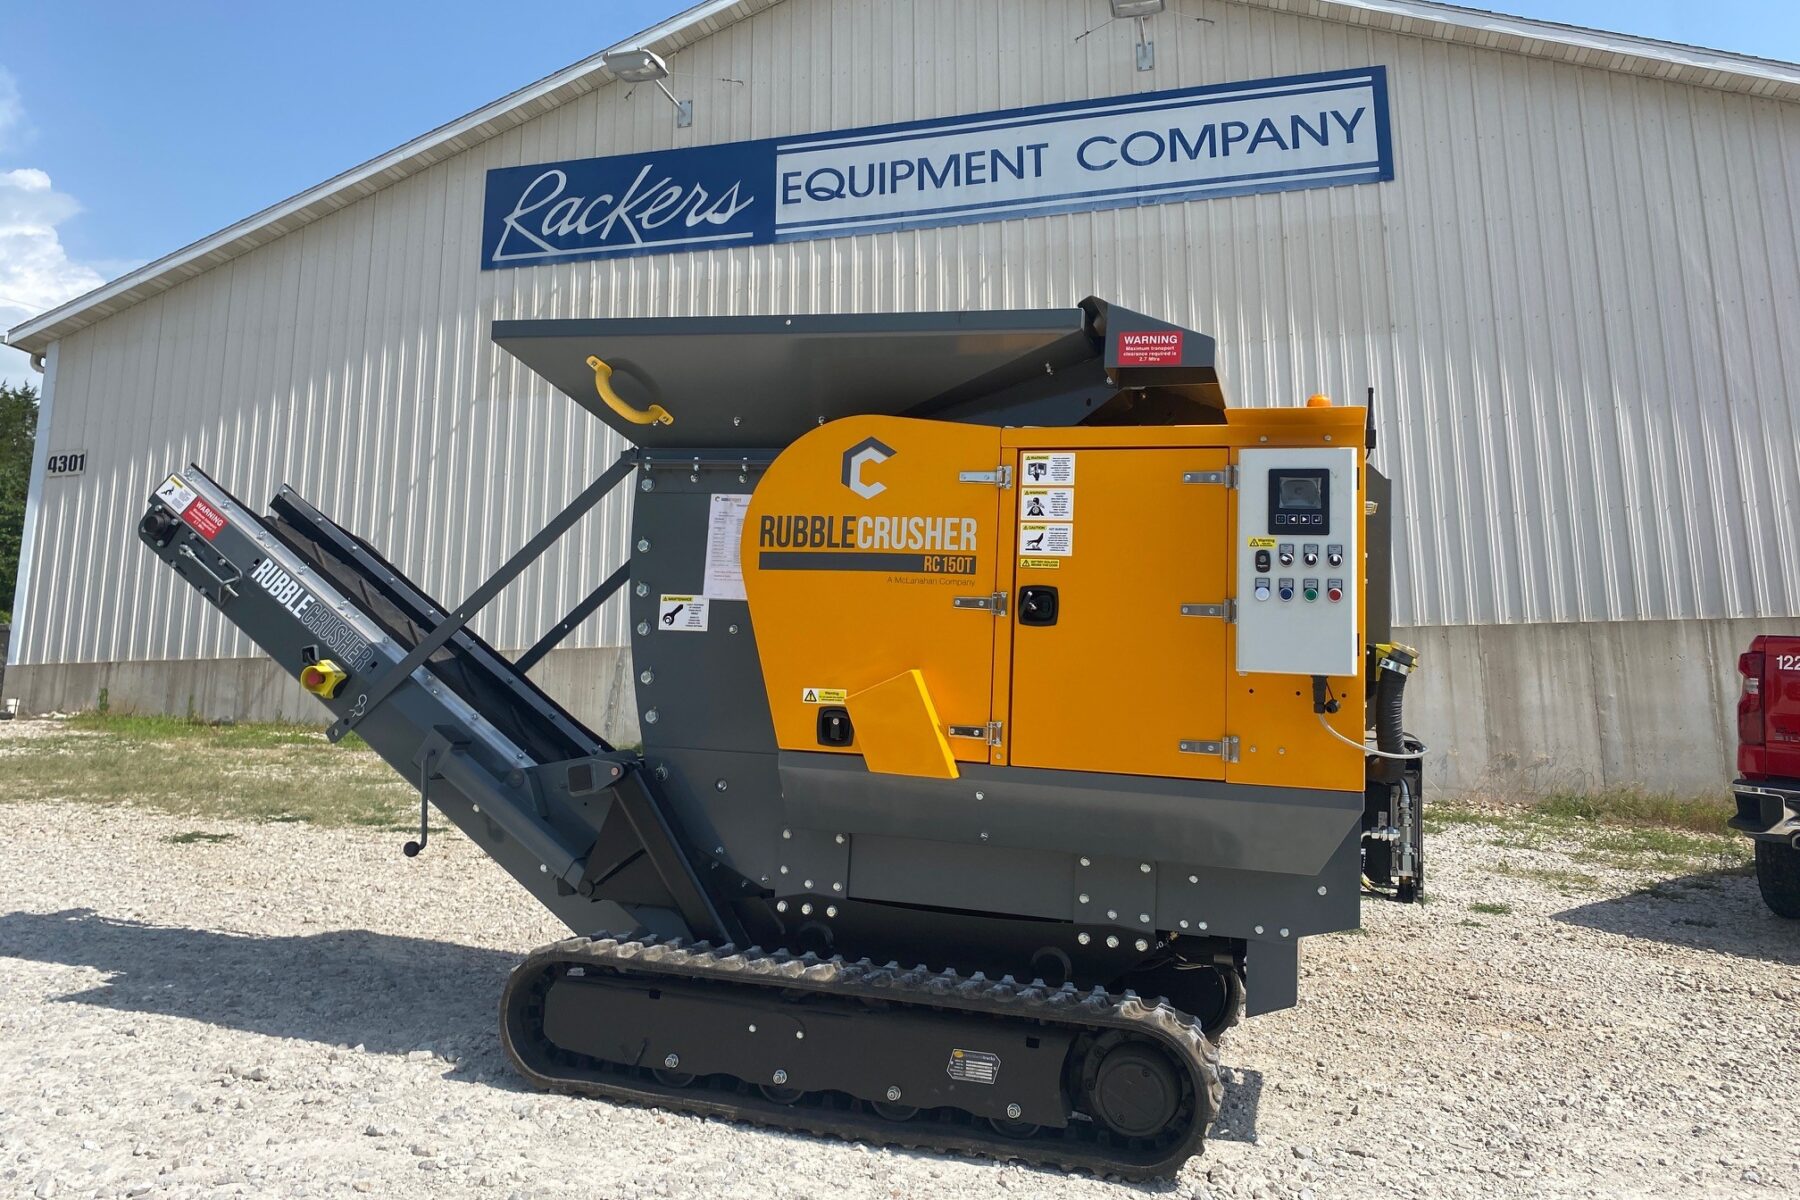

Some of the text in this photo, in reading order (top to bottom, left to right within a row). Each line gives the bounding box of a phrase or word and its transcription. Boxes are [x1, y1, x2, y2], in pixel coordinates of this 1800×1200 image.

[782, 143, 1049, 205] EQUIPMENT
[1076, 107, 1366, 171] COMPANY
[1124, 335, 1178, 344] WARNING
[47, 453, 85, 473] 4301
[196, 501, 224, 527] WARNING
[887, 576, 976, 588] A McLanahan Company
[1776, 654, 1800, 670] 122
